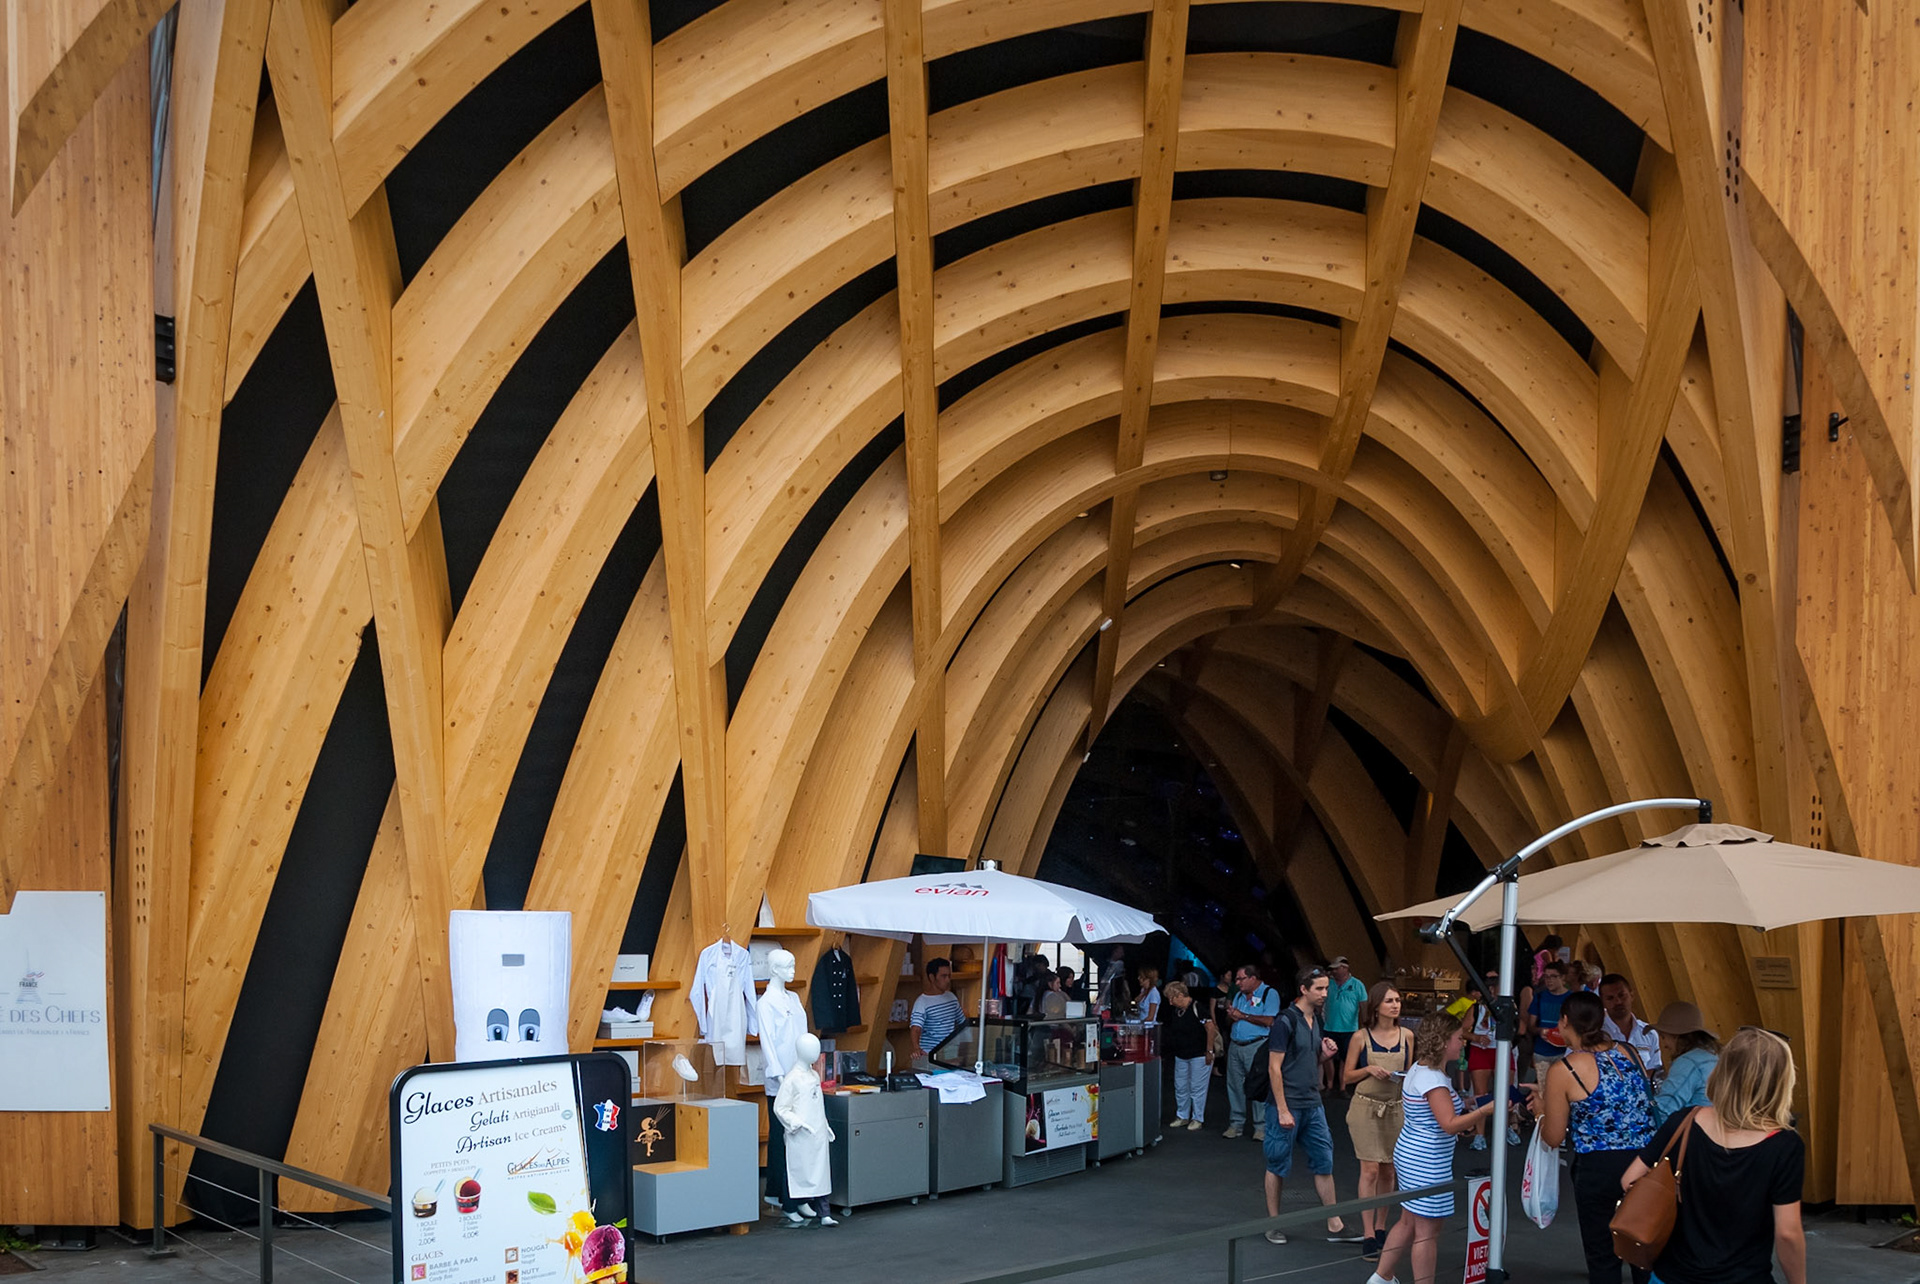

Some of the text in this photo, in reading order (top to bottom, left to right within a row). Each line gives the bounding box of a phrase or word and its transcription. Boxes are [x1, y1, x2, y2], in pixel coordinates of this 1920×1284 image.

[915, 887, 989, 897] evian
[10, 1009, 41, 1023] DES
[45, 1005, 101, 1023] CHEFS
[403, 1080, 557, 1125] Glaces Artisanales
[469, 1102, 560, 1132] Gelati Artigianali
[455, 1123, 567, 1154] Artisan Ice Creams
[431, 1161, 452, 1169] PETITS
[453, 1159, 469, 1167] POTS
[545, 1157, 570, 1168] ALPES
[420, 1219, 437, 1227] BOULE
[521, 1243, 549, 1253] NOUGAT
[411, 1250, 444, 1262] GLACES
[429, 1260, 452, 1270] BARBE
[460, 1256, 478, 1265] PAPA
[521, 1267, 539, 1276] NUTY
